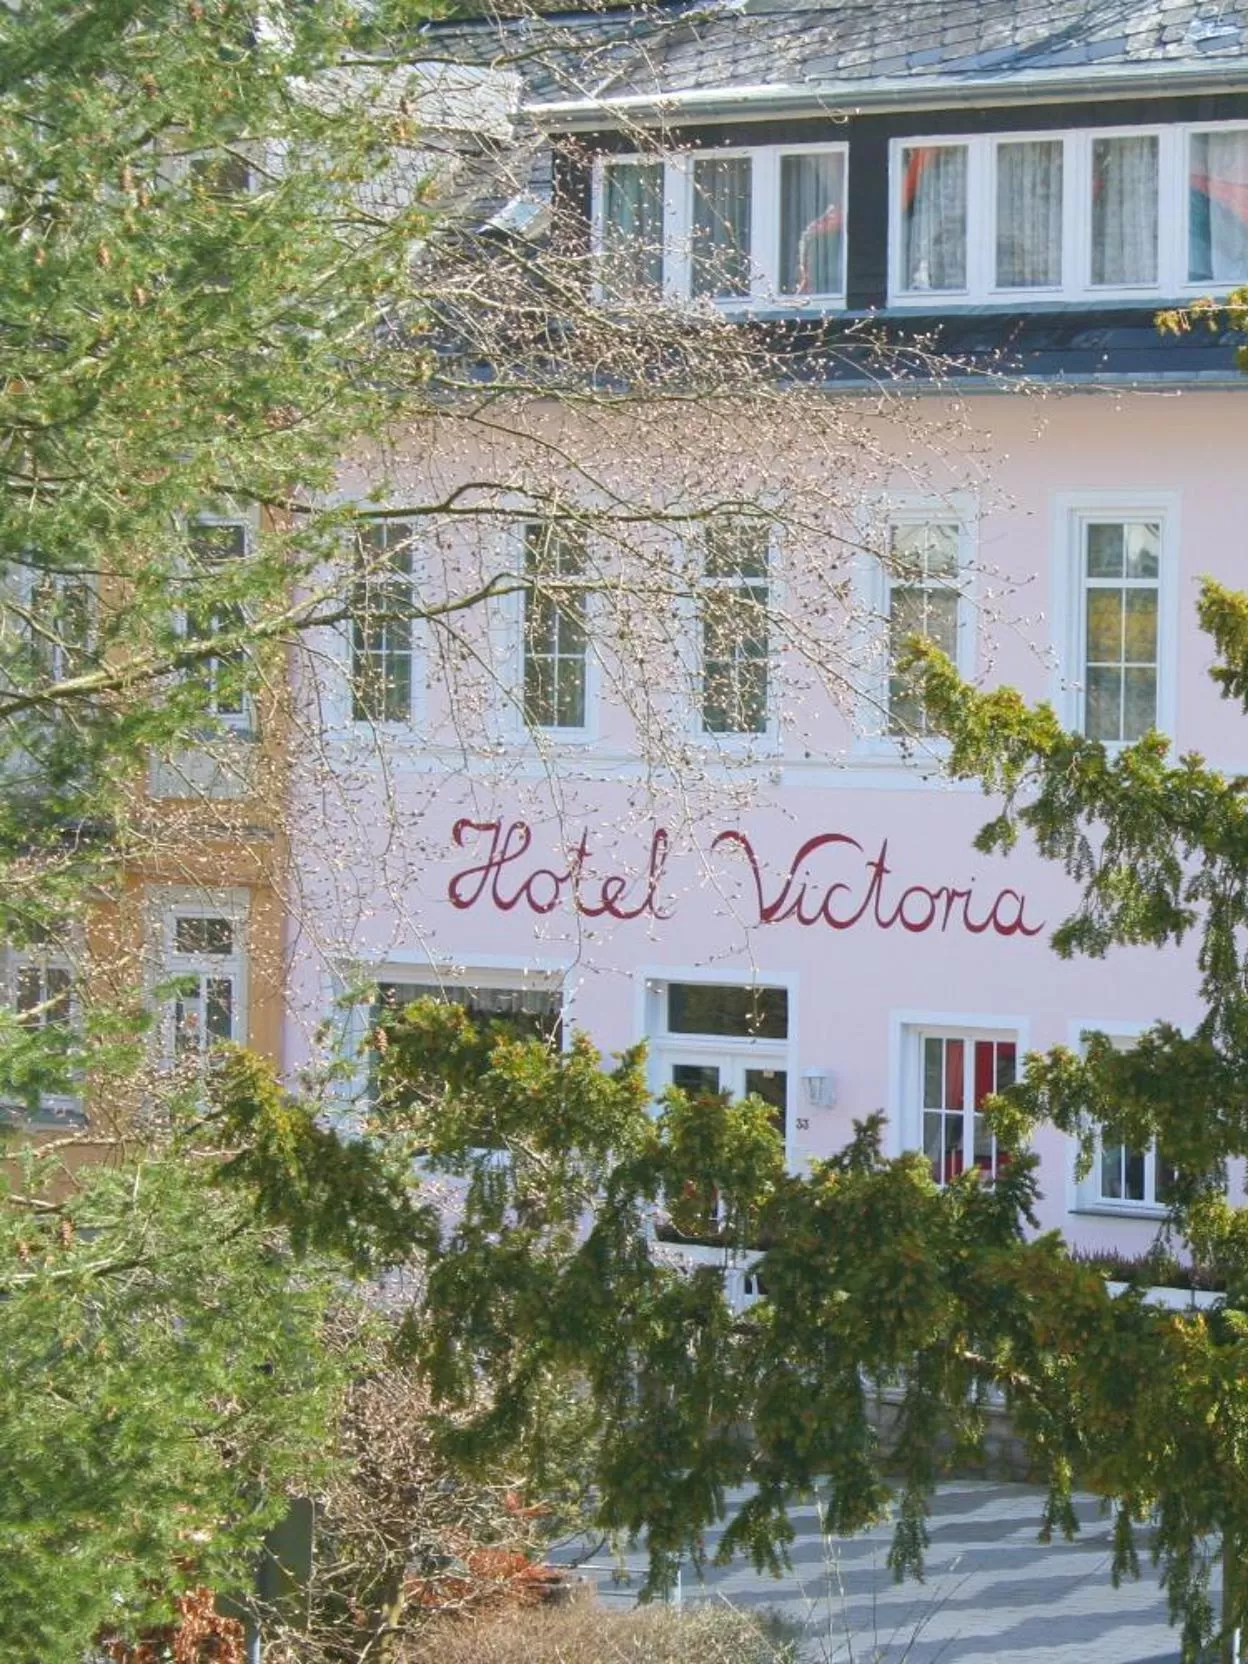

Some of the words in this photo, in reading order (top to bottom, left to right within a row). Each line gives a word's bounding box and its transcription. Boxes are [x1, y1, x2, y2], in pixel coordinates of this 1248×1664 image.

[447, 818, 676, 920] Hotel
[711, 830, 1046, 936] Victoria
[796, 1118, 809, 1130] 33
